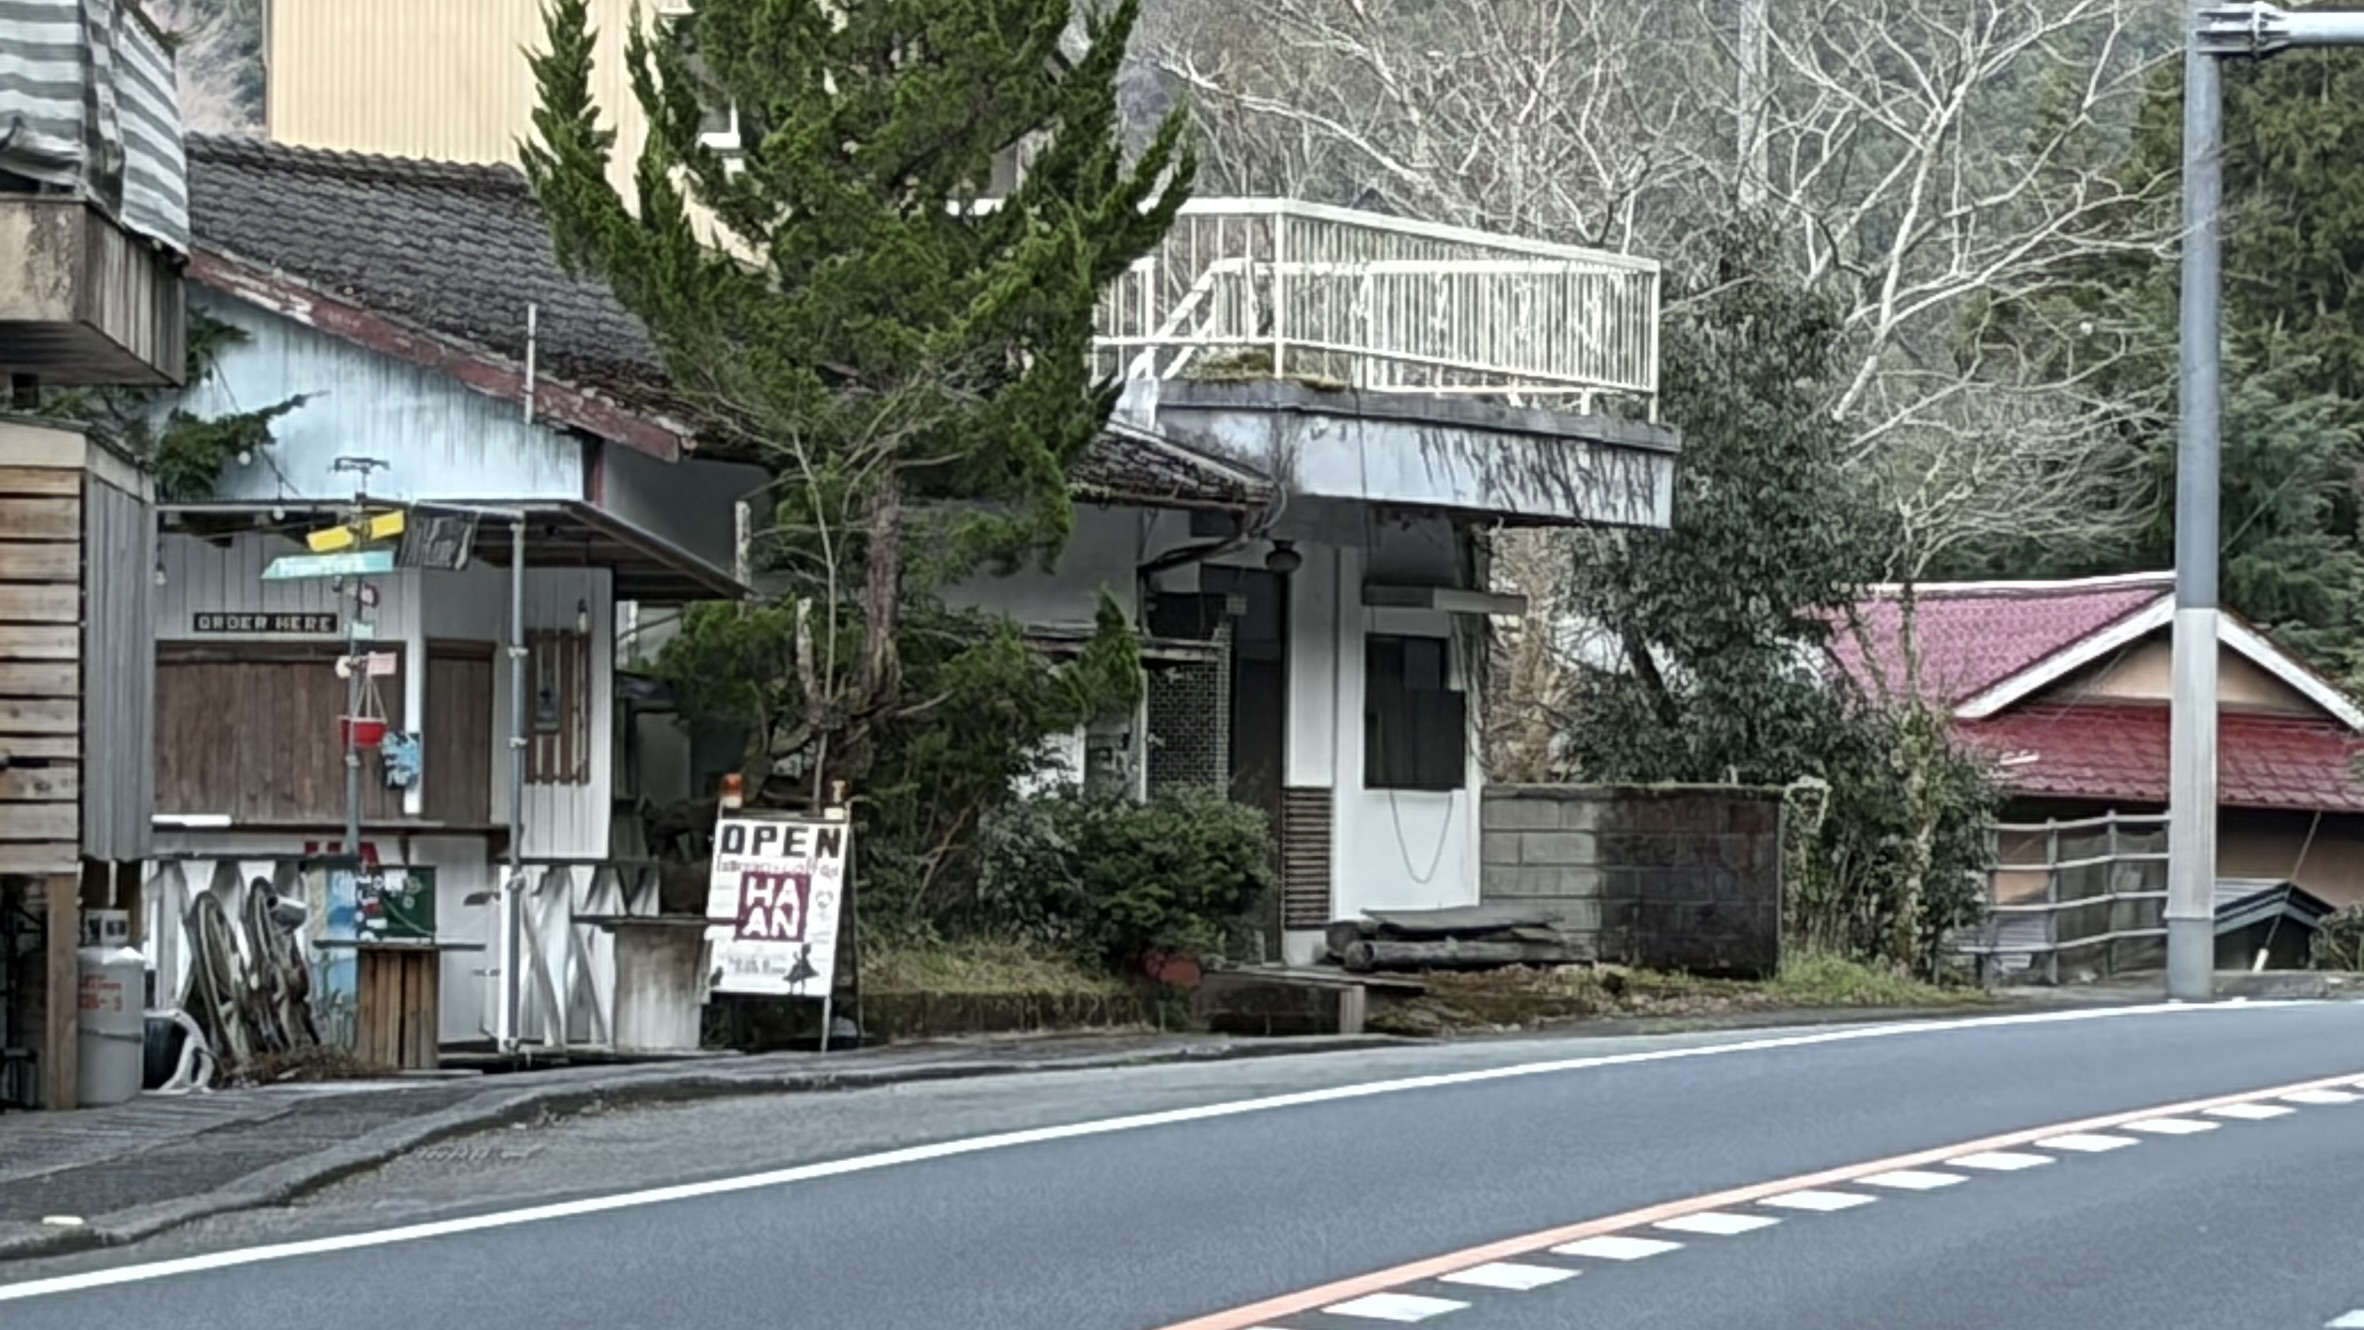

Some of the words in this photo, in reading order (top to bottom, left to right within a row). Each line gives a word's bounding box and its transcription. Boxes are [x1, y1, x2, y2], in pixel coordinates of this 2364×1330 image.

[198, 614, 267, 630] ORDER
[275, 615, 331, 632] HERE
[721, 824, 841, 858] OPEN
[747, 877, 799, 907] HA
[742, 906, 799, 937] AN
